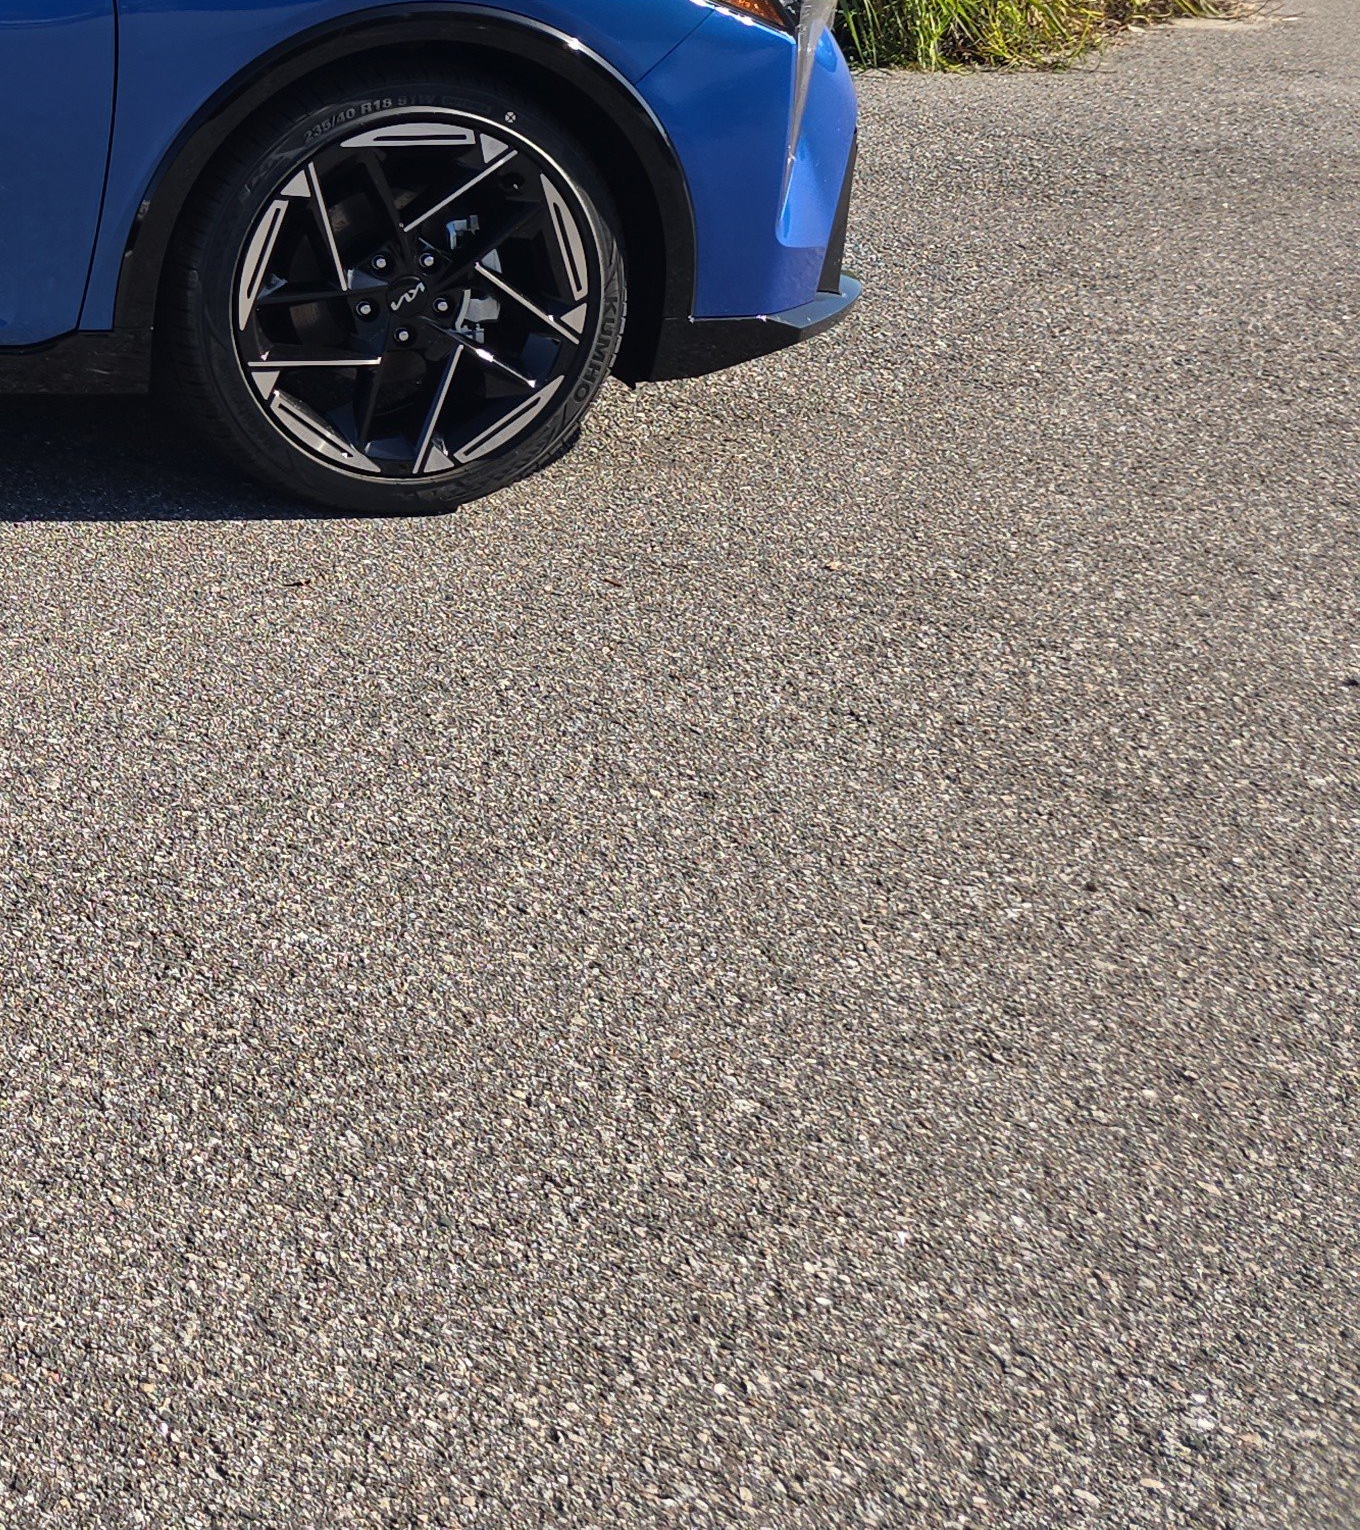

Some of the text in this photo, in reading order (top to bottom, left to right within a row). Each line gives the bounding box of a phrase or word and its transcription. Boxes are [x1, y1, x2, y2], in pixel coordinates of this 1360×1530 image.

[304, 107, 356, 142] 235/40
[360, 97, 392, 114] R18
[573, 296, 618, 402] KUMHO
